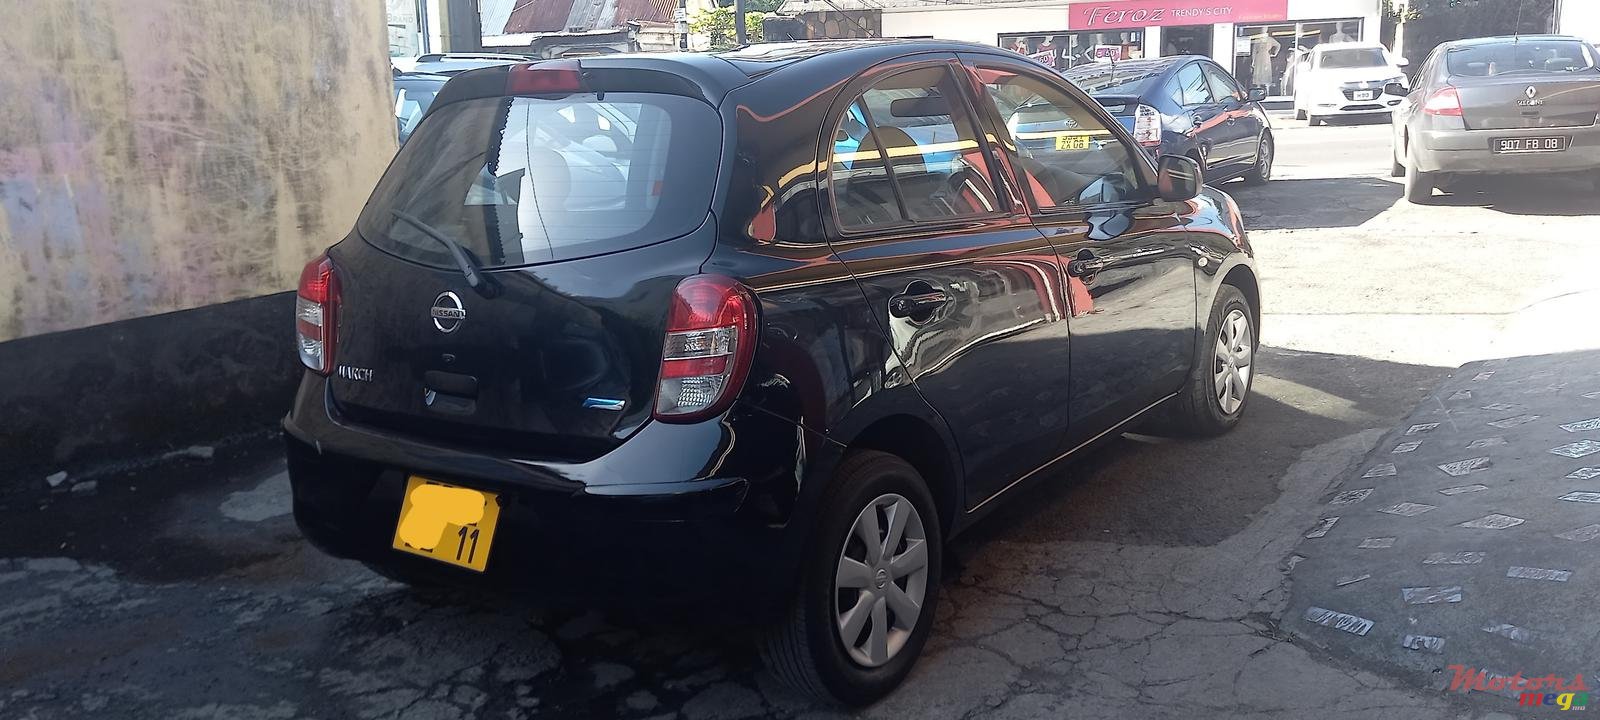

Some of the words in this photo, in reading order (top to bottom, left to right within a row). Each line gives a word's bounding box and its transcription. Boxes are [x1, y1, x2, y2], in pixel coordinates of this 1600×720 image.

[1083, 6, 1165, 26] Feroz
[1171, 8, 1211, 17] TRENDY'S
[1213, 6, 1233, 16] CITY
[1500, 140, 1520, 150] 907
[1526, 139, 1539, 149] FB
[1544, 138, 1558, 149] 08
[432, 309, 460, 318] NISSAN
[456, 525, 480, 564] 11
